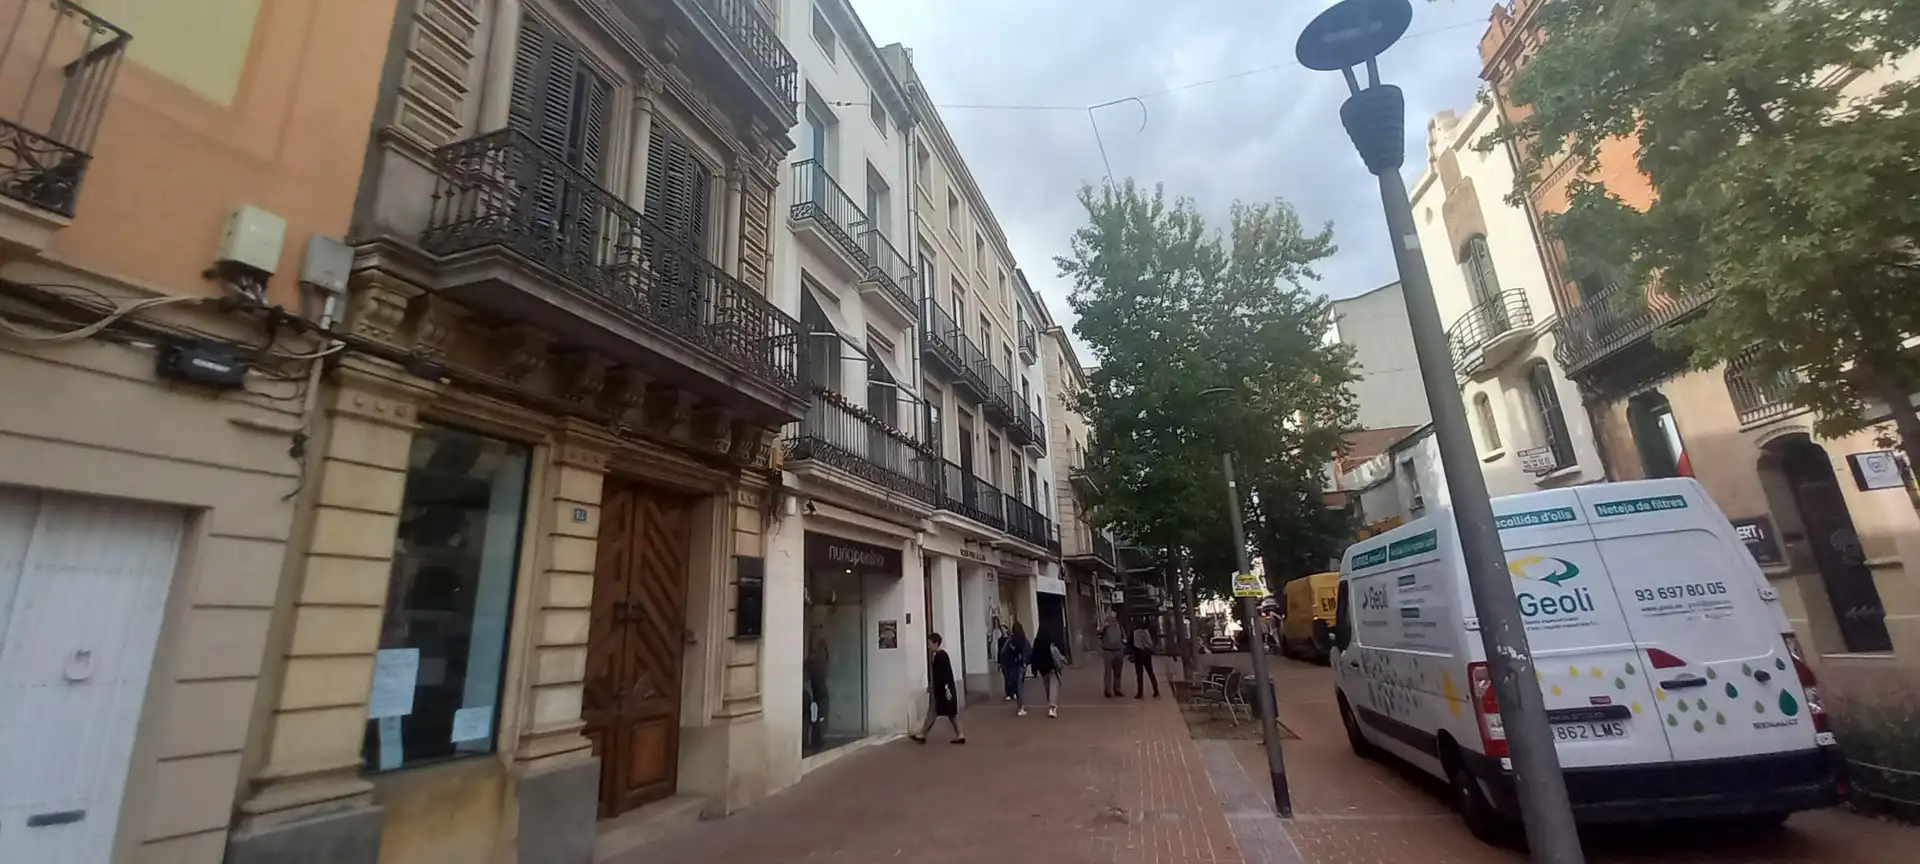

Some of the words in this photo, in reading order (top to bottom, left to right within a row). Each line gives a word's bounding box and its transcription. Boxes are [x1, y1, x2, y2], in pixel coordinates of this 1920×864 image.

[1597, 503, 1635, 516] Neteja
[1636, 501, 1650, 511] de
[1651, 497, 1685, 509] filtres
[1495, 512, 1538, 528] ecollida
[1541, 510, 1573, 522] d'olis
[1736, 524, 1757, 539] ERT
[1635, 588, 1654, 602] 93
[1657, 585, 1684, 600] 697
[1686, 583, 1705, 597] 80
[1706, 581, 1727, 595] 05
[1517, 586, 1595, 617] Geoli
[1551, 724, 1589, 741] 862
[1590, 721, 1624, 739] LMS
